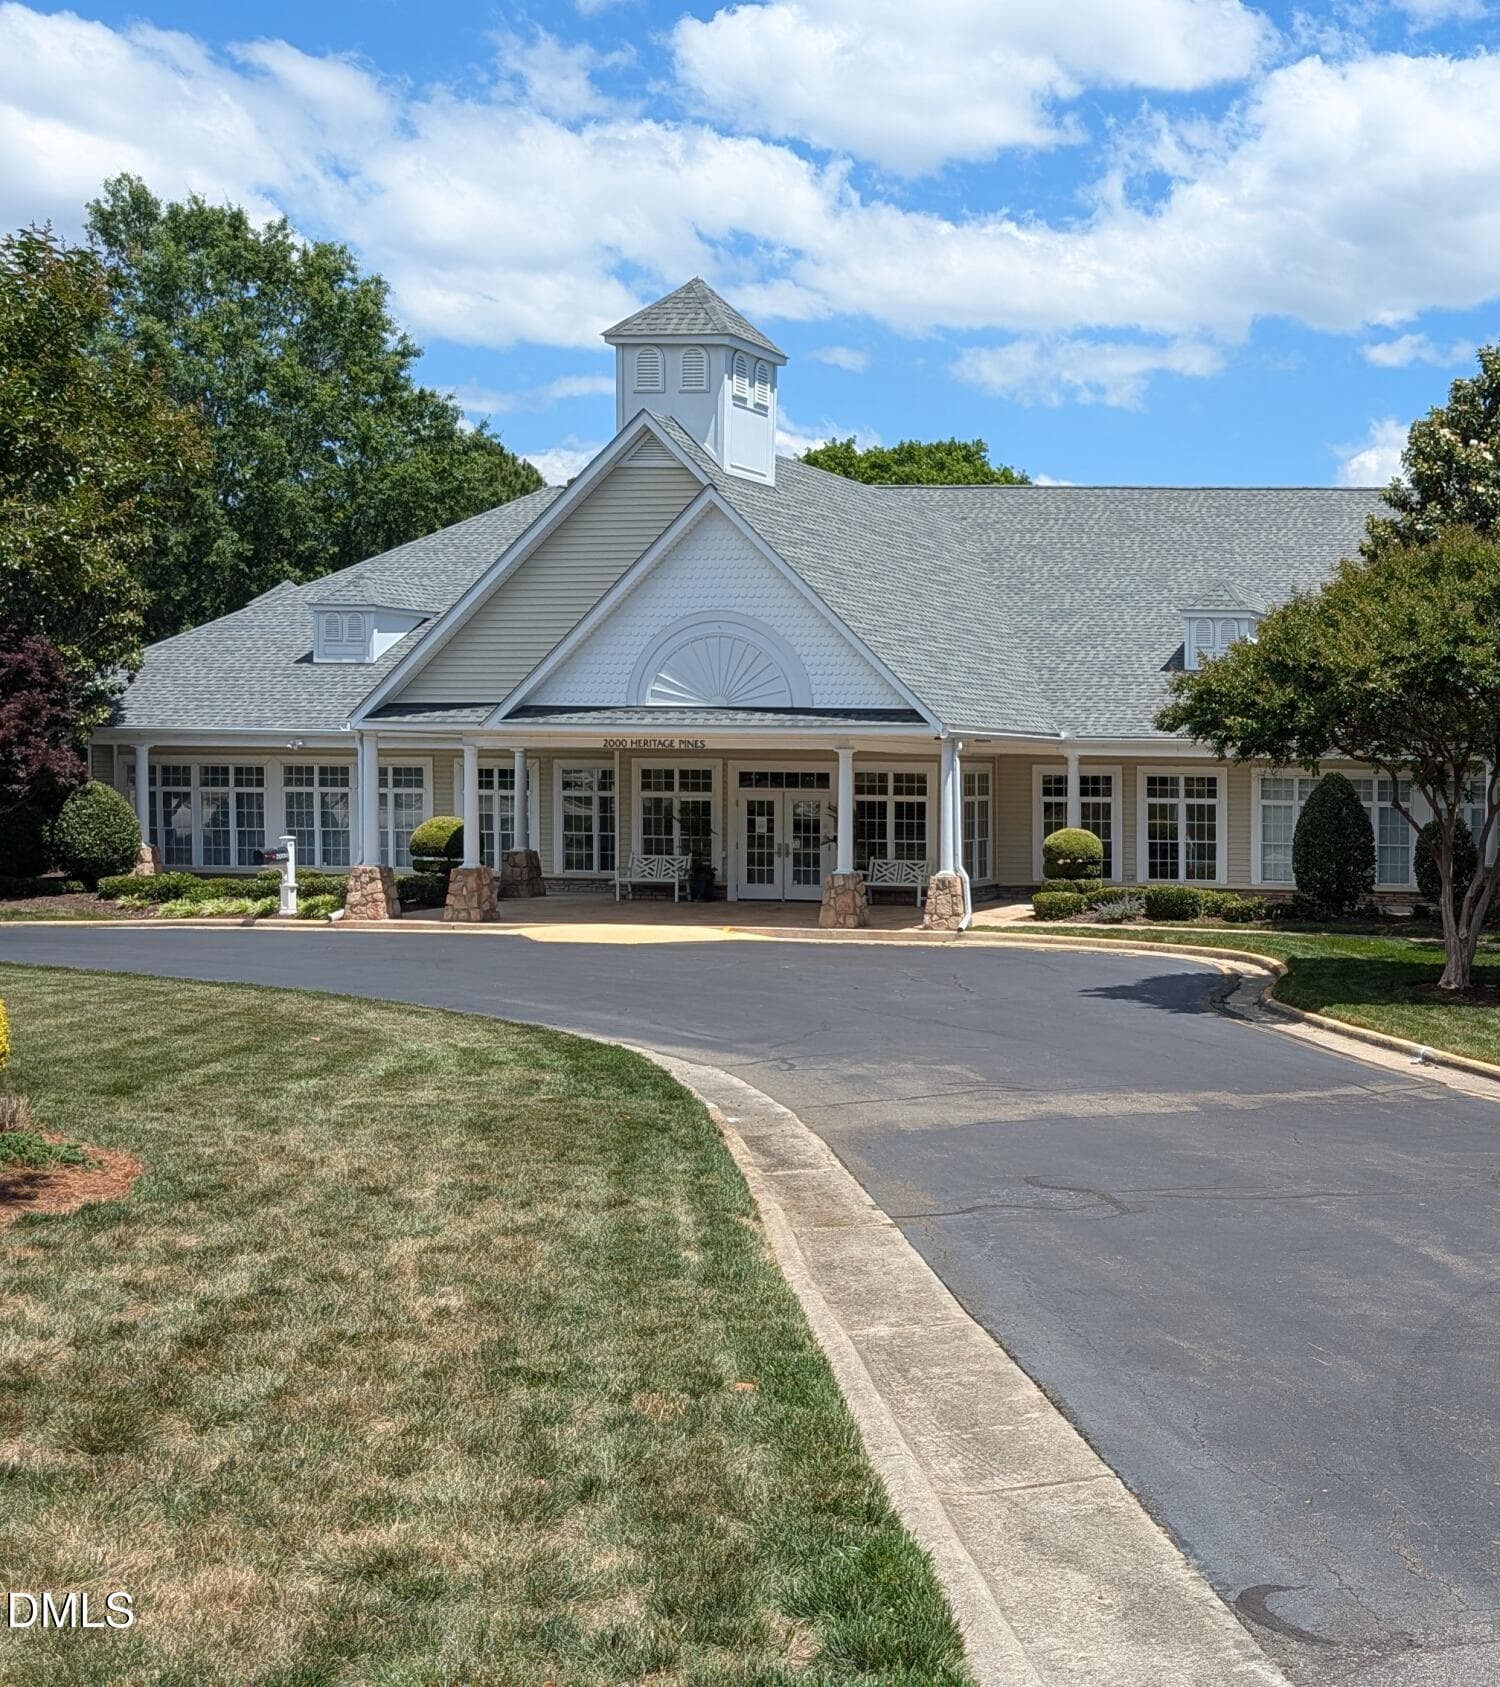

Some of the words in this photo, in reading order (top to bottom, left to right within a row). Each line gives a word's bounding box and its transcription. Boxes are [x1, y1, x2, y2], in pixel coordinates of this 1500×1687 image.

[603, 739, 628, 748] 2000
[630, 739, 676, 749] HERITAGE
[678, 739, 706, 749] PINES
